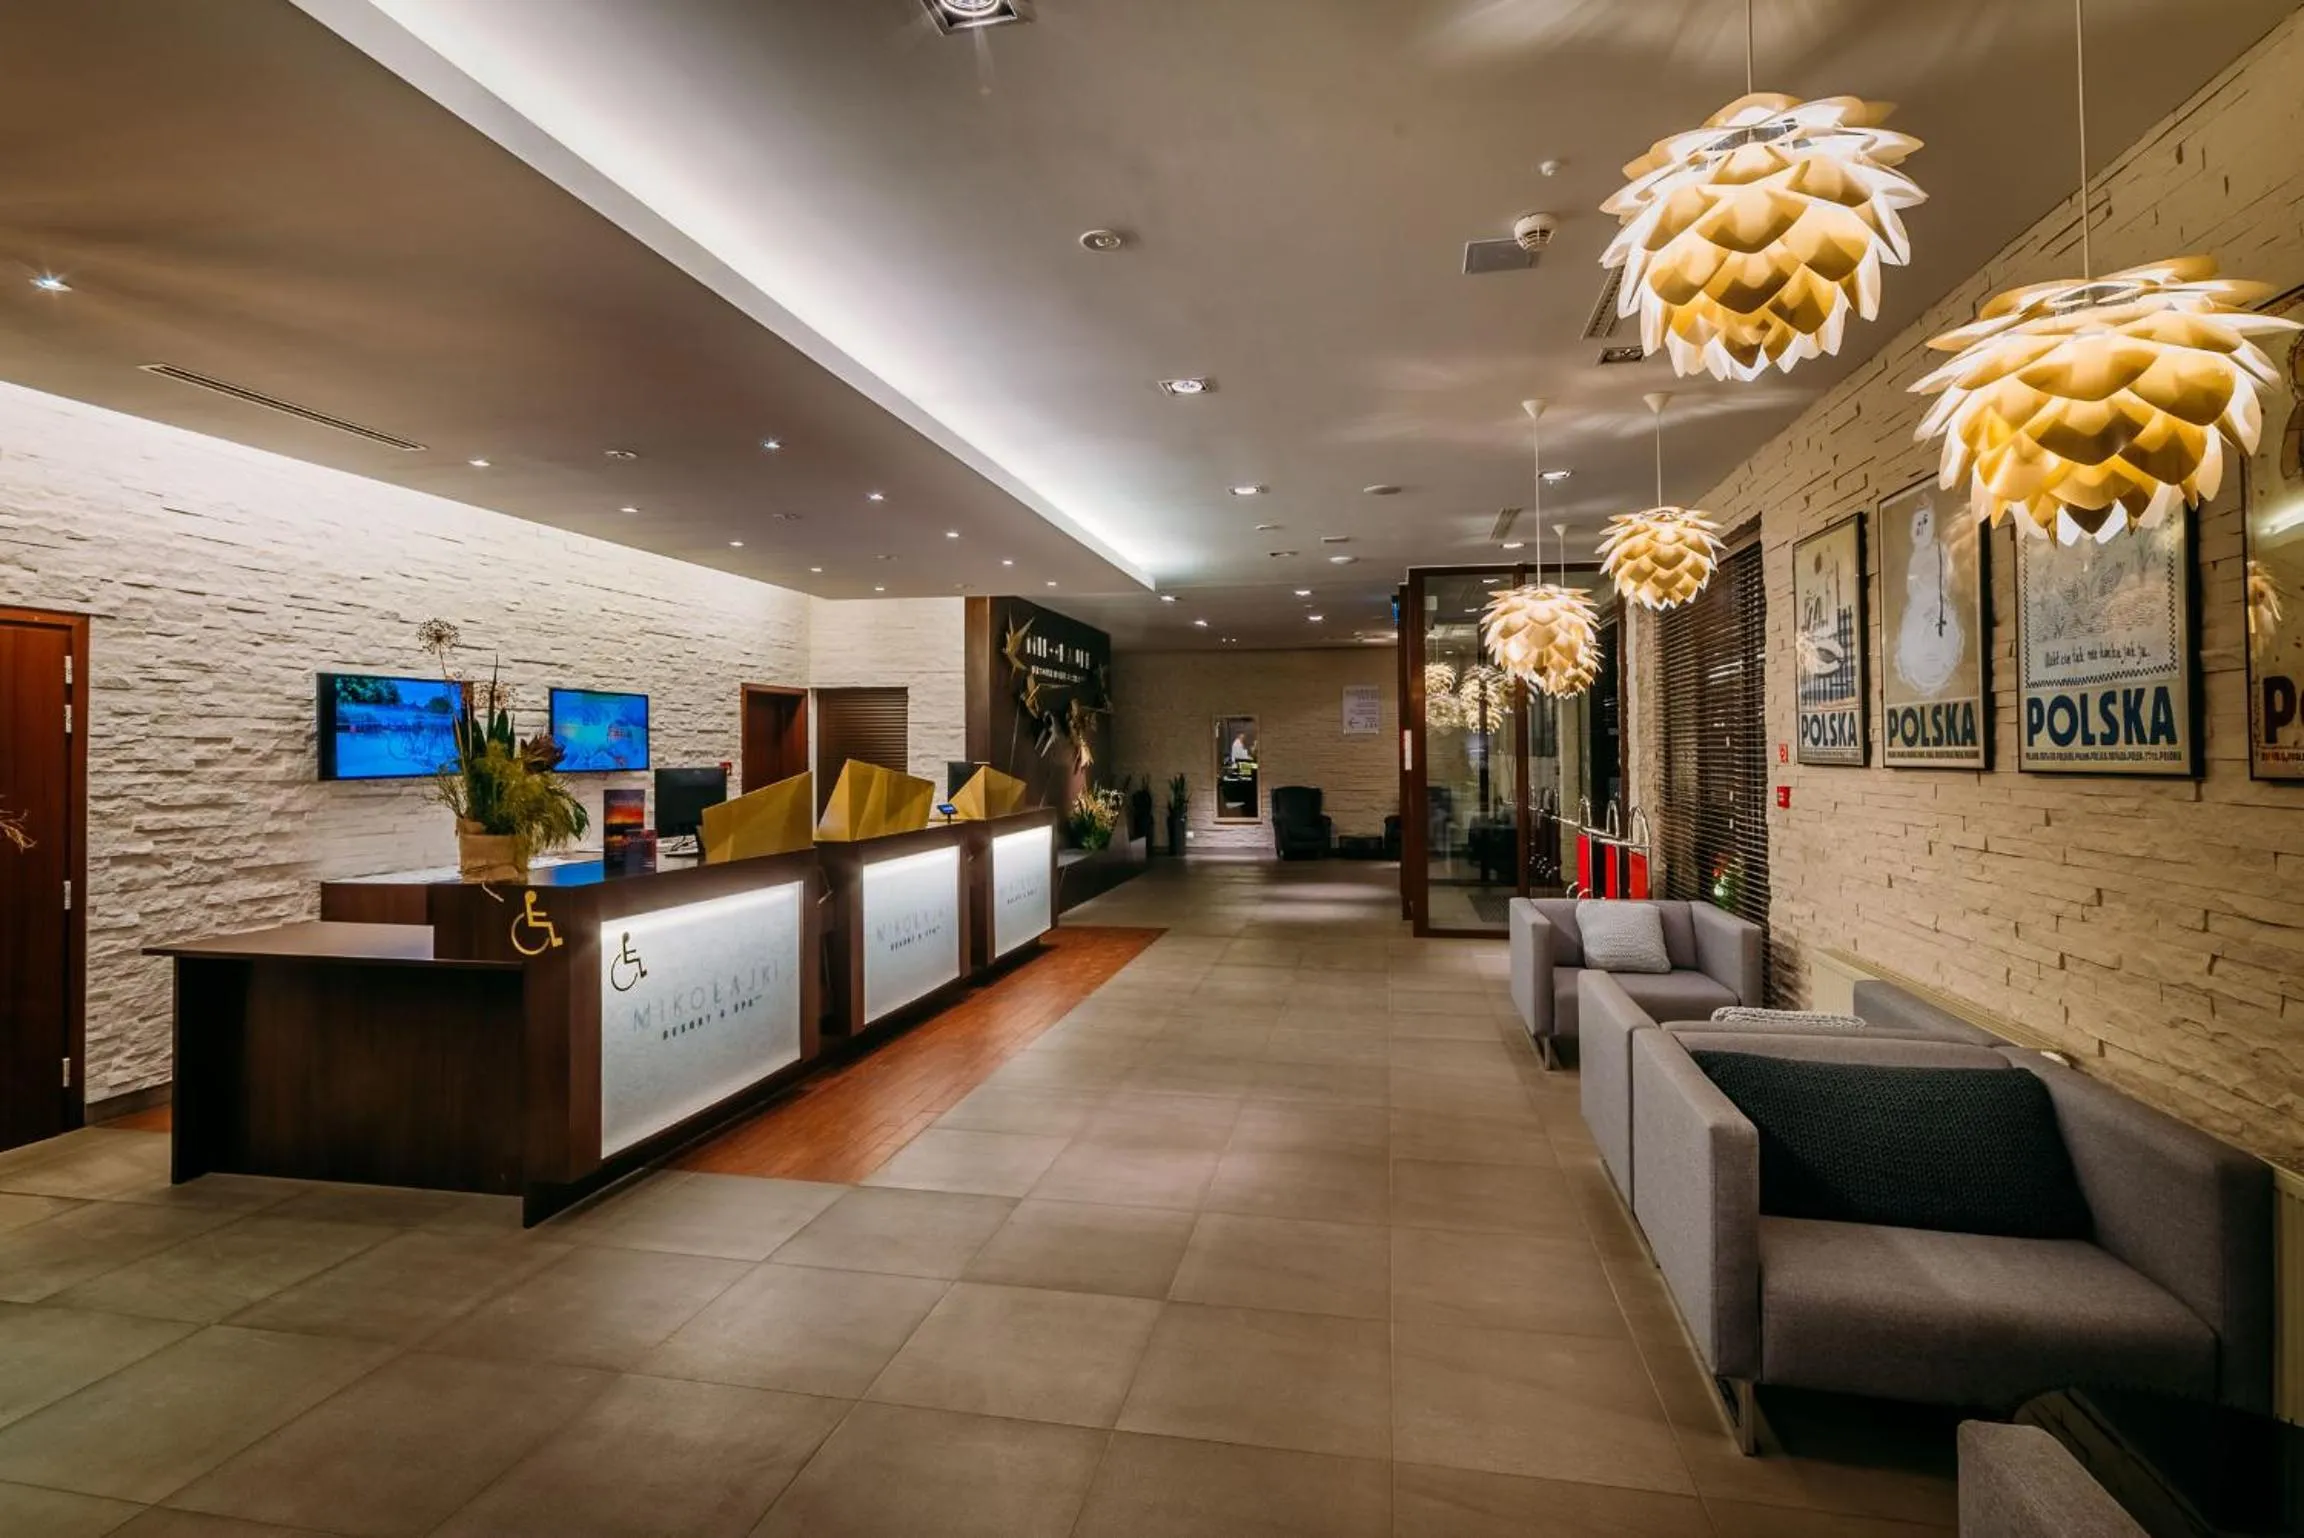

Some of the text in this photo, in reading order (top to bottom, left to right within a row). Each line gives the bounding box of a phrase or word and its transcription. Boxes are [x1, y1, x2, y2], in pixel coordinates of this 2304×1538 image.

[1801, 711, 1858, 747] POLSKA
[1887, 702, 1978, 748] POLSKA
[2027, 686, 2178, 747] POLSKA
[2263, 675, 2304, 744] P
